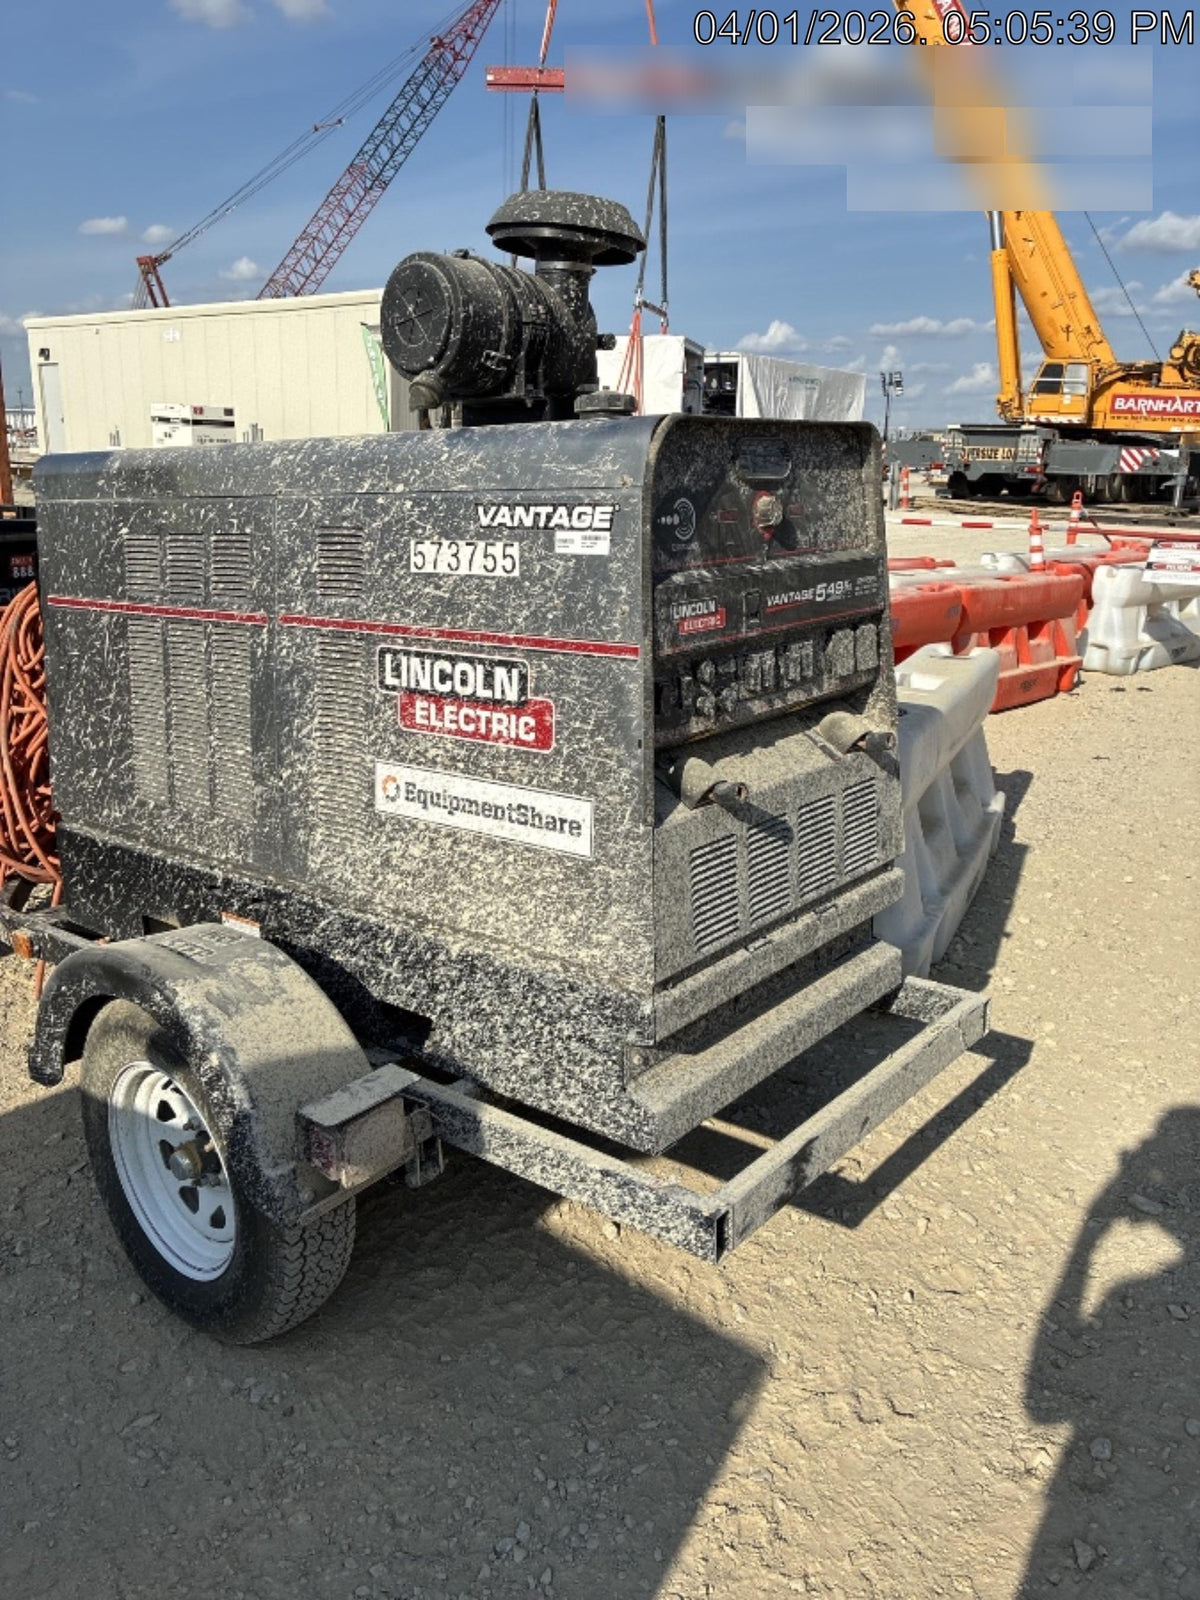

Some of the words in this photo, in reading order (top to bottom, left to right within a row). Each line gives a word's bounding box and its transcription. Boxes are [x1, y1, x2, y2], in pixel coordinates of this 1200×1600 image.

[476, 504, 614, 530] VANTAGE
[413, 541, 517, 575] 573755
[674, 600, 716, 619] LINCOLN
[384, 653, 519, 702] LINCOLN
[415, 700, 536, 742] ELECTRIC
[404, 781, 583, 838] EquipmentShare
